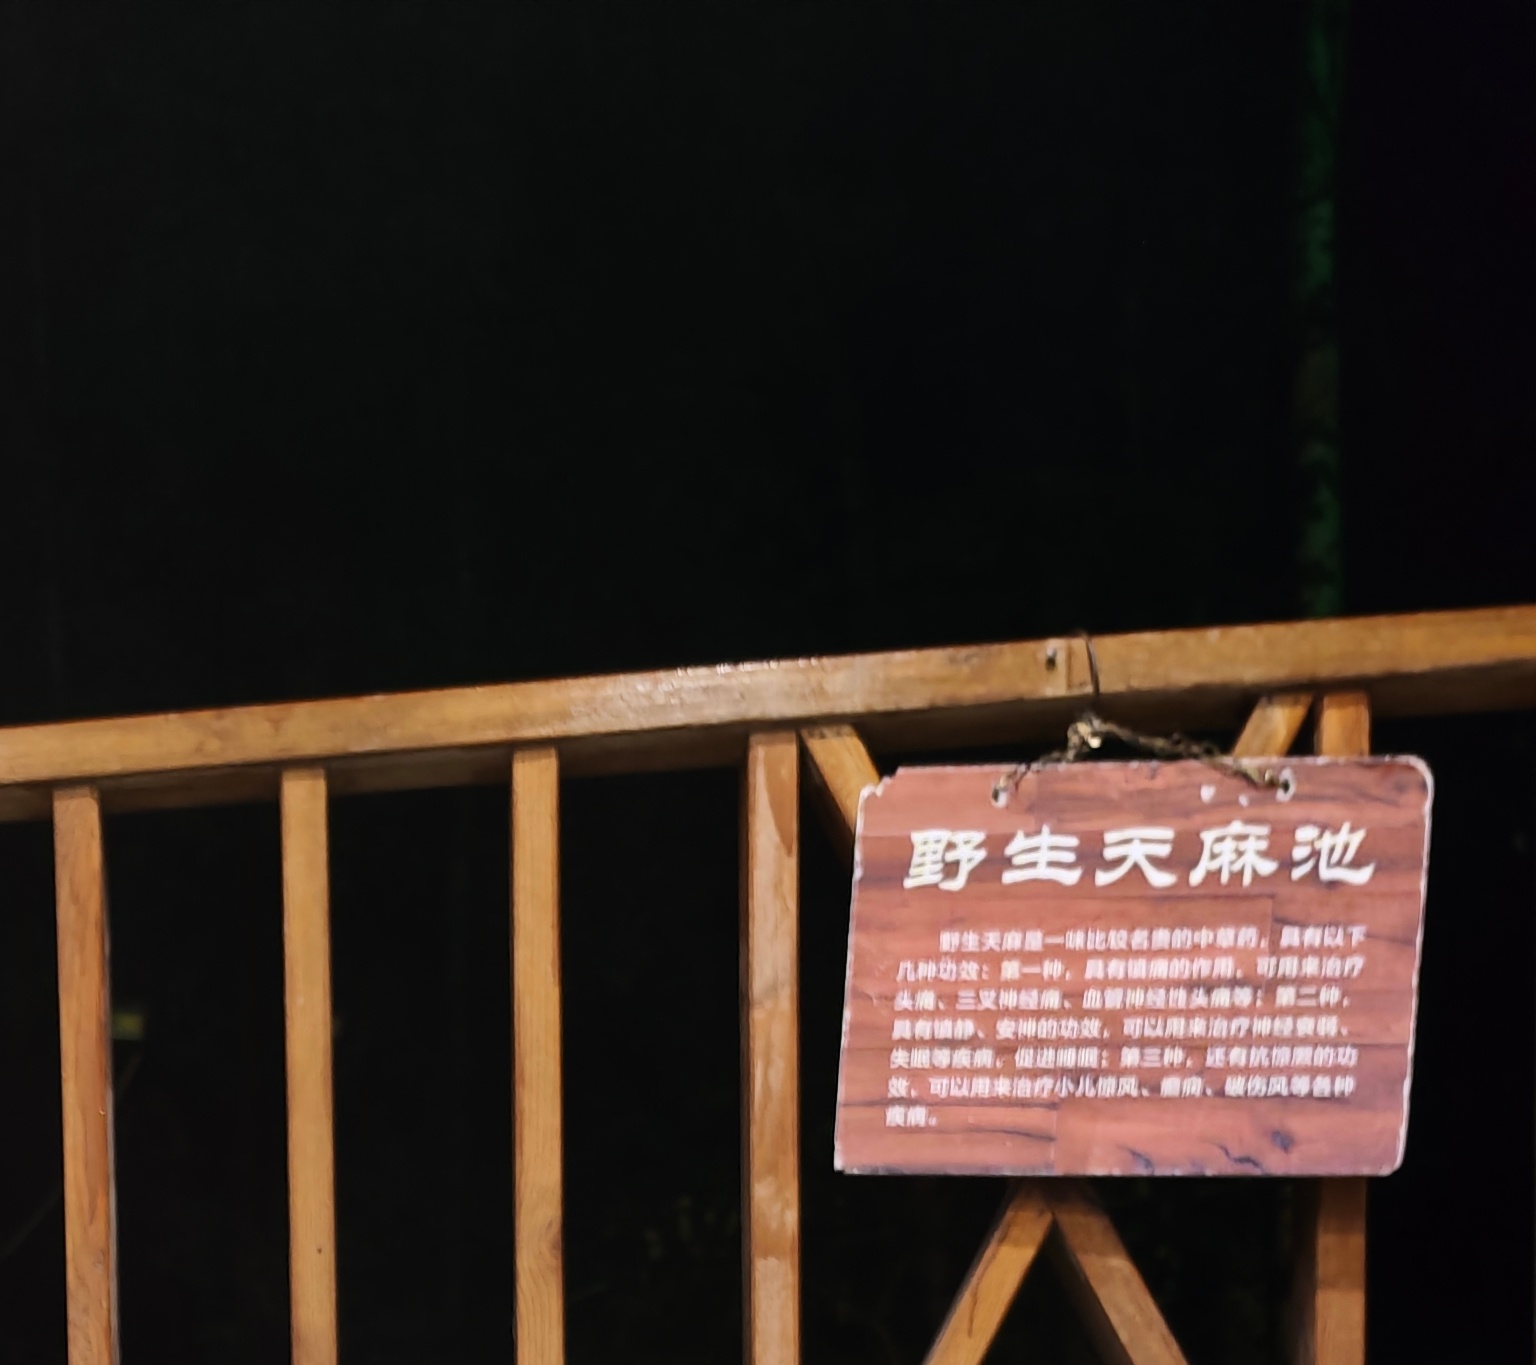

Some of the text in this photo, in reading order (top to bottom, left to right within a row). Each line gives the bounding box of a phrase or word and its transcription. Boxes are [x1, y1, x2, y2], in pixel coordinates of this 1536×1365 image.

[903, 819, 1376, 891] 野生天麻池
